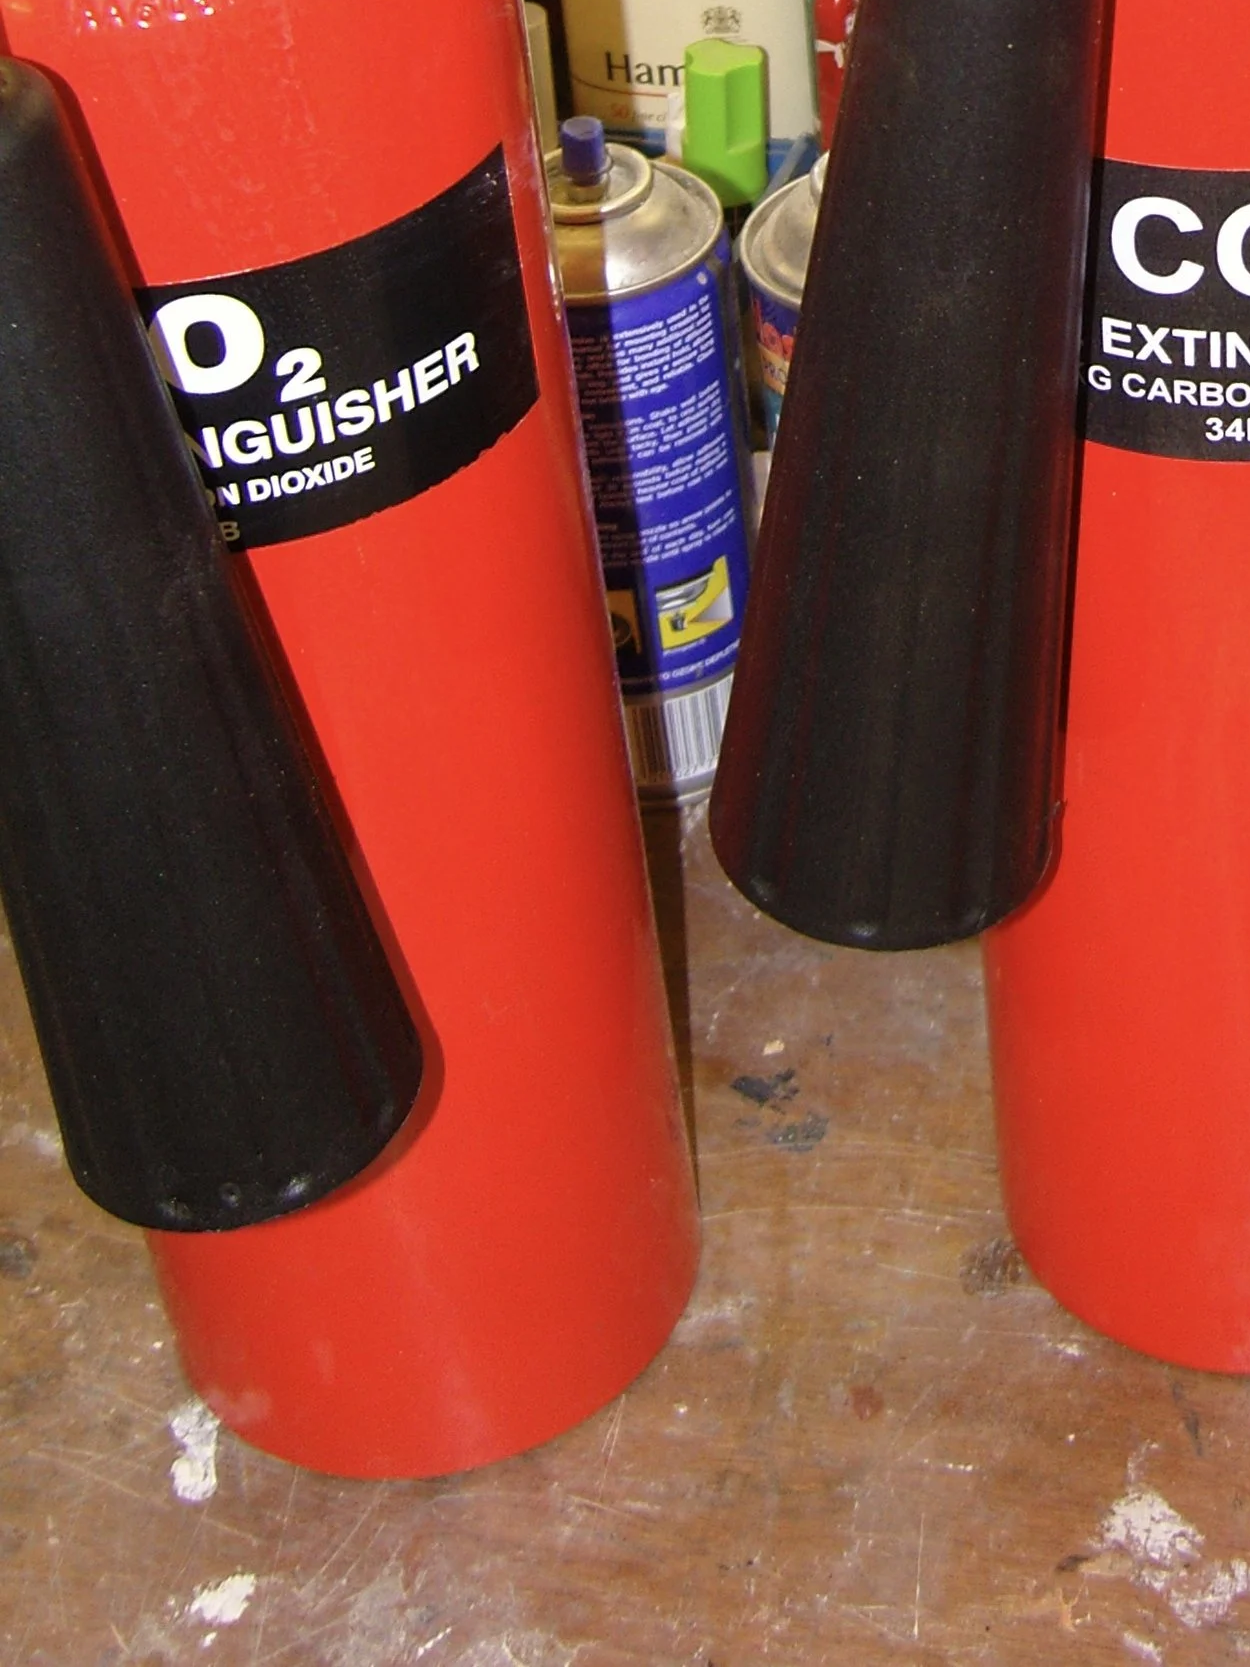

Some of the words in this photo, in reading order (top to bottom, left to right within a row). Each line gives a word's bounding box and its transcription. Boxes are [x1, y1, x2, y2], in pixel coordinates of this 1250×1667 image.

[605, 51, 685, 86] Ham
[150, 293, 327, 403] O2
[185, 331, 480, 470] NGUISHER
[246, 446, 376, 503] DIOXIDE
